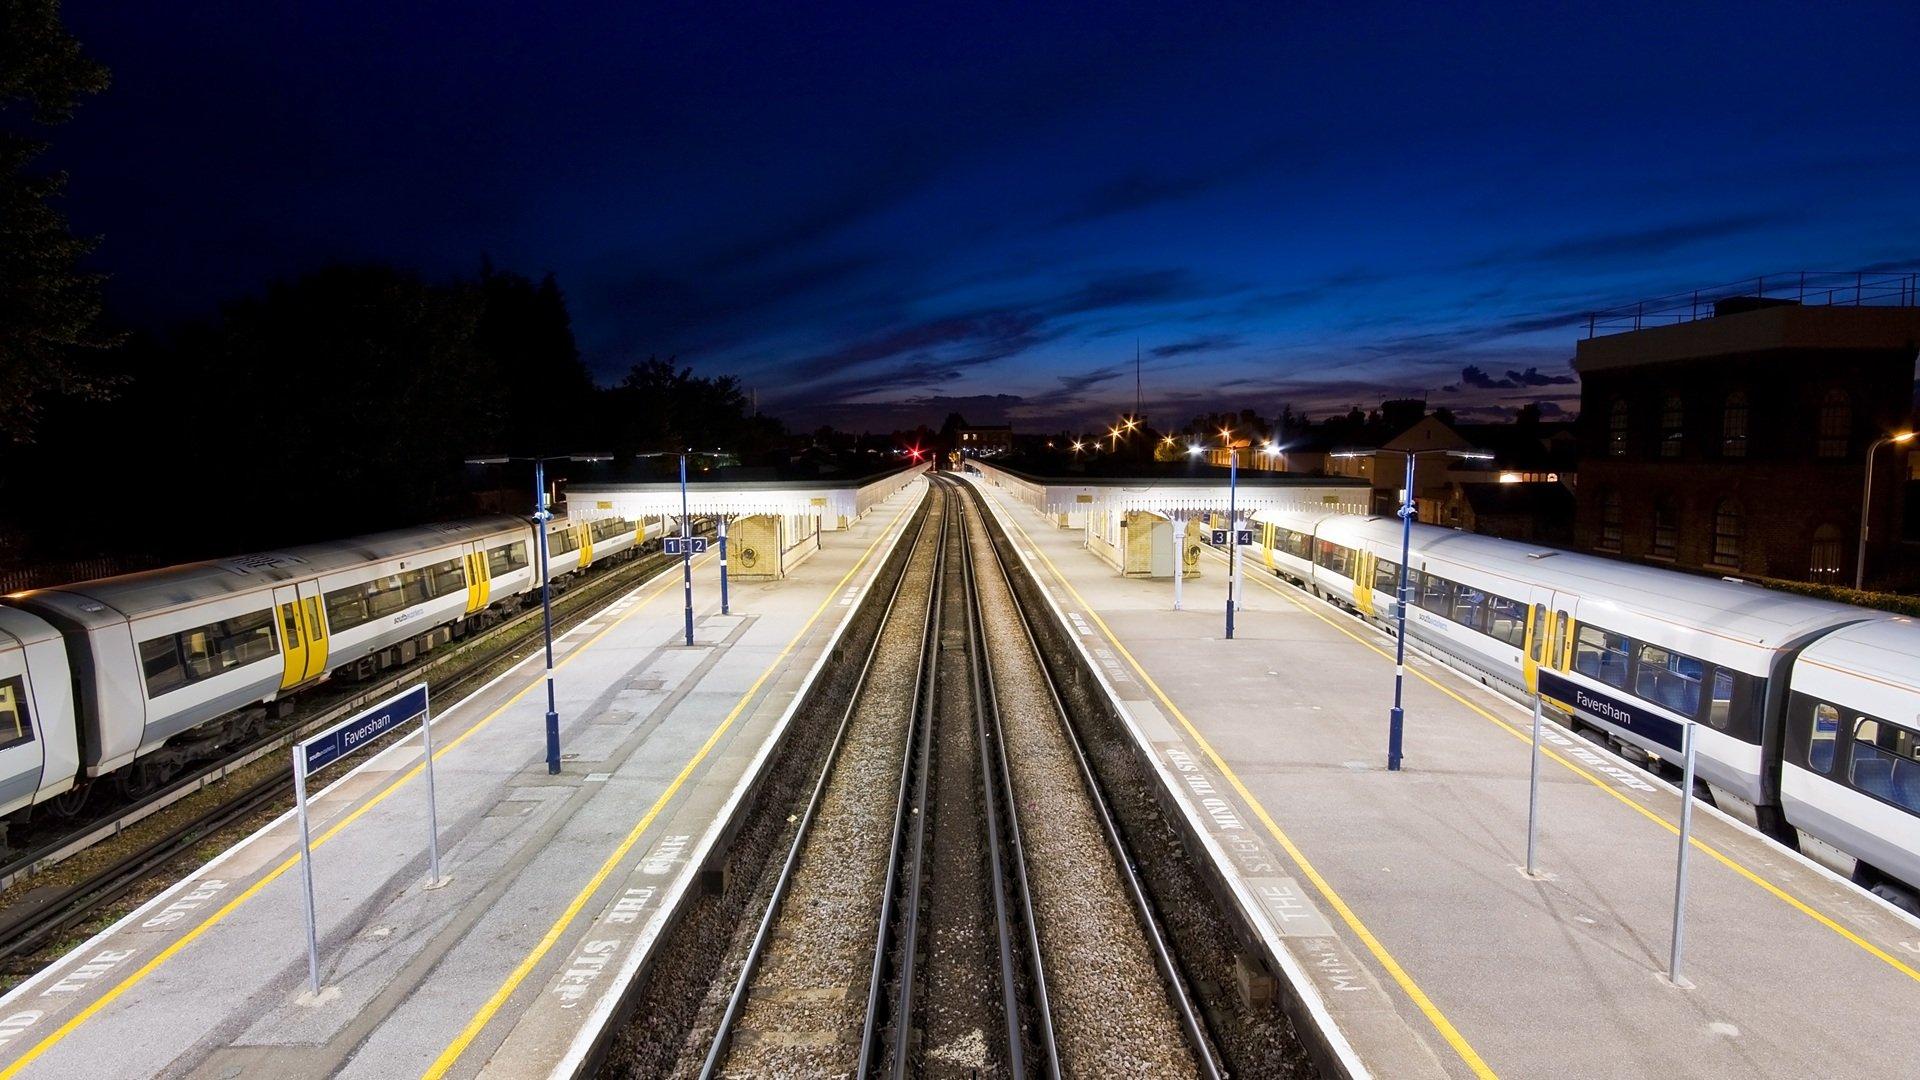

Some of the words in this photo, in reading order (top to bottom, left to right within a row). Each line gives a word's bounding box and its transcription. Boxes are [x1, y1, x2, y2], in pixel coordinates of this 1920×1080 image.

[668, 541, 675, 552] 1
[695, 540, 703, 552] 2
[1216, 532, 1224, 544] 3
[1241, 532, 1249, 544] 4
[1577, 690, 1631, 725] Faversham
[344, 714, 391, 747] Faversham
[1166, 749, 1199, 772] STEP
[1184, 774, 1216, 796] THE
[1598, 766, 1658, 792] STEP
[1201, 798, 1244, 830] MIND
[604, 886, 657, 924] THE
[1259, 885, 1310, 922] THE
[40, 949, 137, 997] THE
[142, 879, 229, 928] STEP
